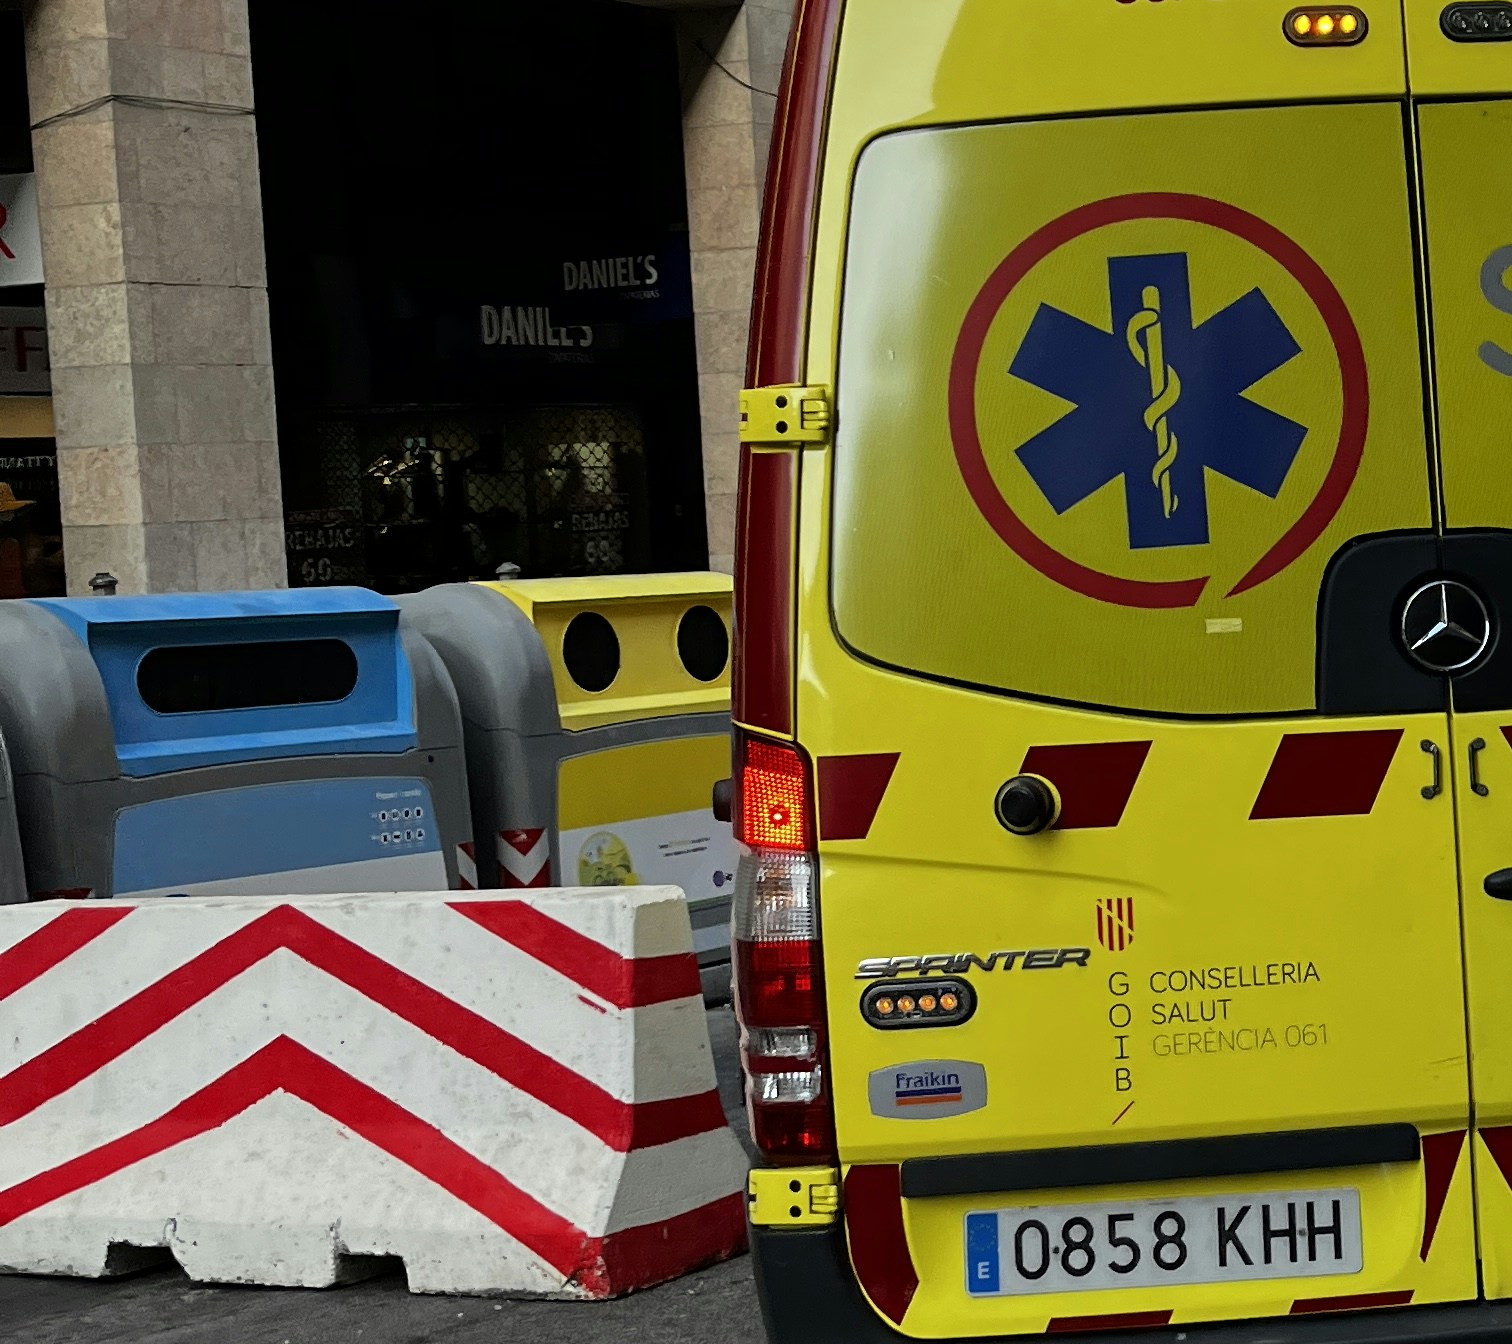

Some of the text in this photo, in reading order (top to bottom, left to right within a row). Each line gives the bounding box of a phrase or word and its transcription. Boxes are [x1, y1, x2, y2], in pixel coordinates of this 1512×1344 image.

[854, 947, 1091, 980] SPRINTER
[1149, 961, 1321, 994] CONSELLERIA
[1151, 999, 1232, 1025] SALUT
[1152, 1023, 1329, 1057] GERÈNCIA 061
[896, 1070, 960, 1089] Fraikin
[977, 1199, 1344, 1281] E 0858 KHH
